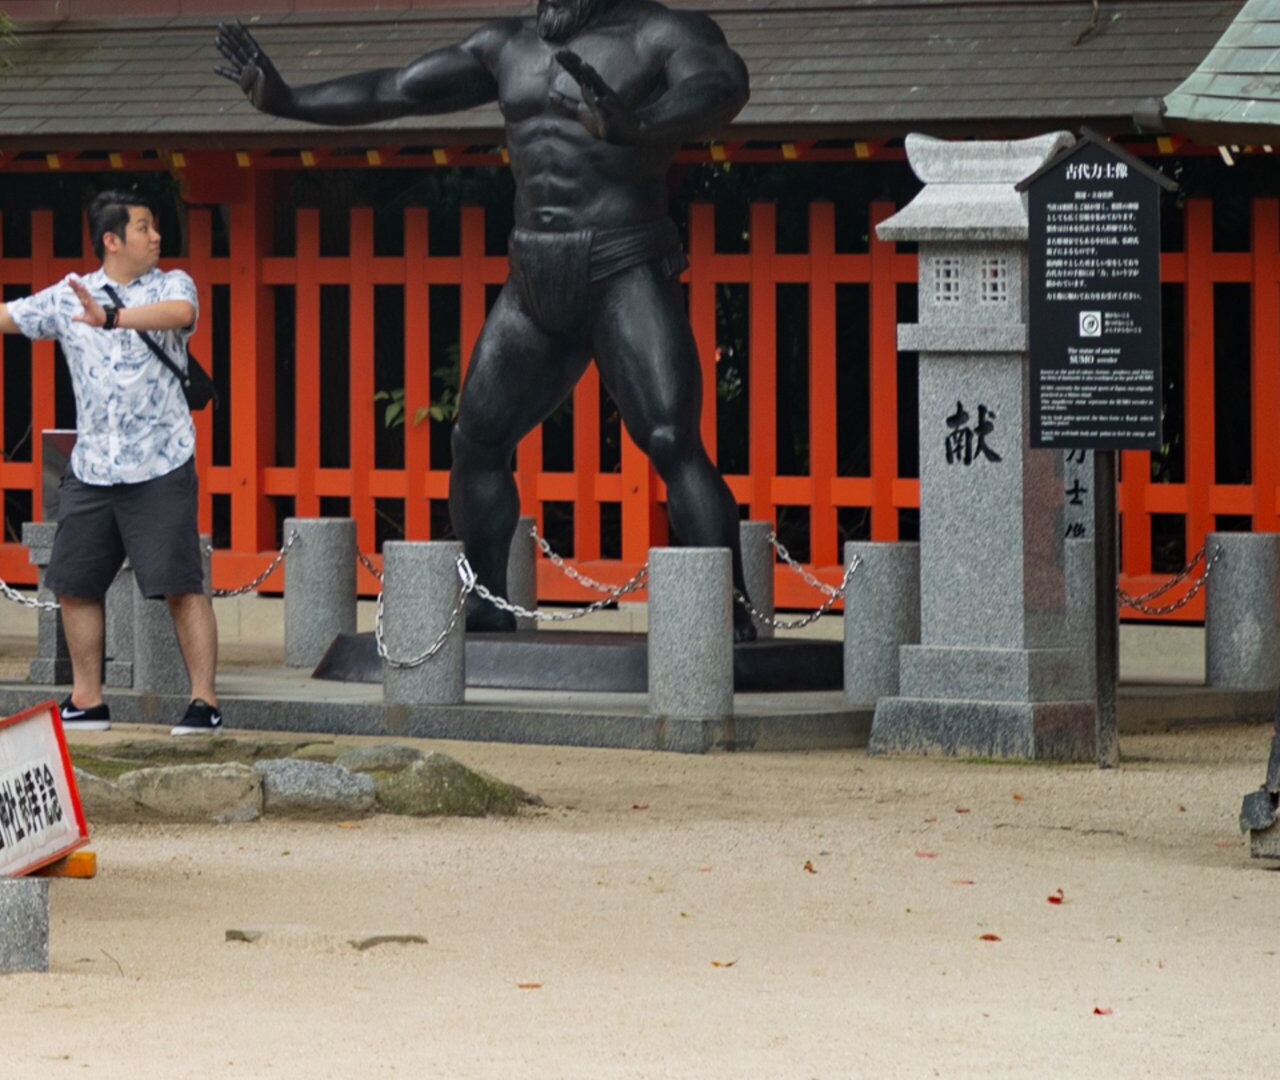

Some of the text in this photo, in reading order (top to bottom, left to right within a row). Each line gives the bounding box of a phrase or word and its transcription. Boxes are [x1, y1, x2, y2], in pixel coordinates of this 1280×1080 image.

[1066, 162, 1129, 180] 古代力士像
[1069, 355, 1094, 364] SUMO
[945, 401, 1002, 466] 献
